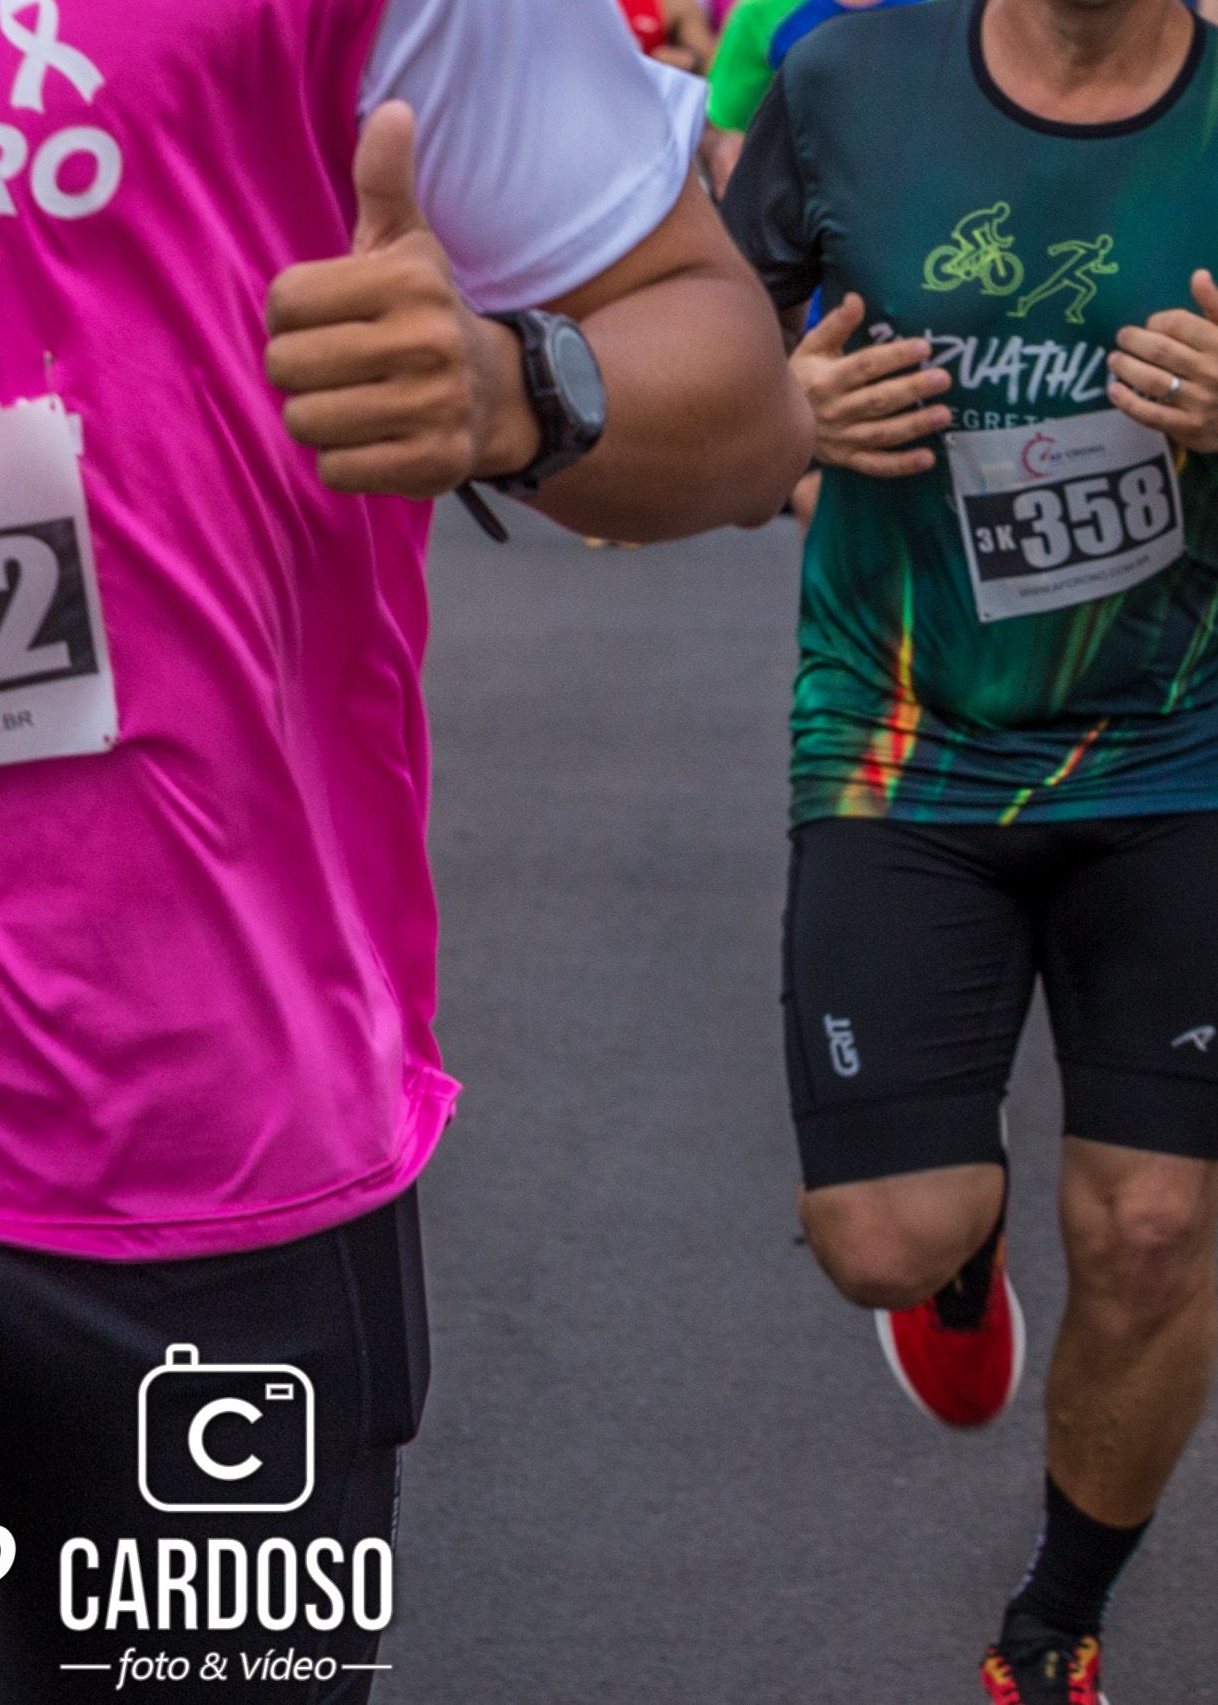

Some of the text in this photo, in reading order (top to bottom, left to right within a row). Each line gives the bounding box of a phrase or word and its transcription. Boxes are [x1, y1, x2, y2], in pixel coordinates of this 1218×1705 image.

[920, 327, 1118, 407] DUATHL
[974, 463, 1171, 570] 3K 358
